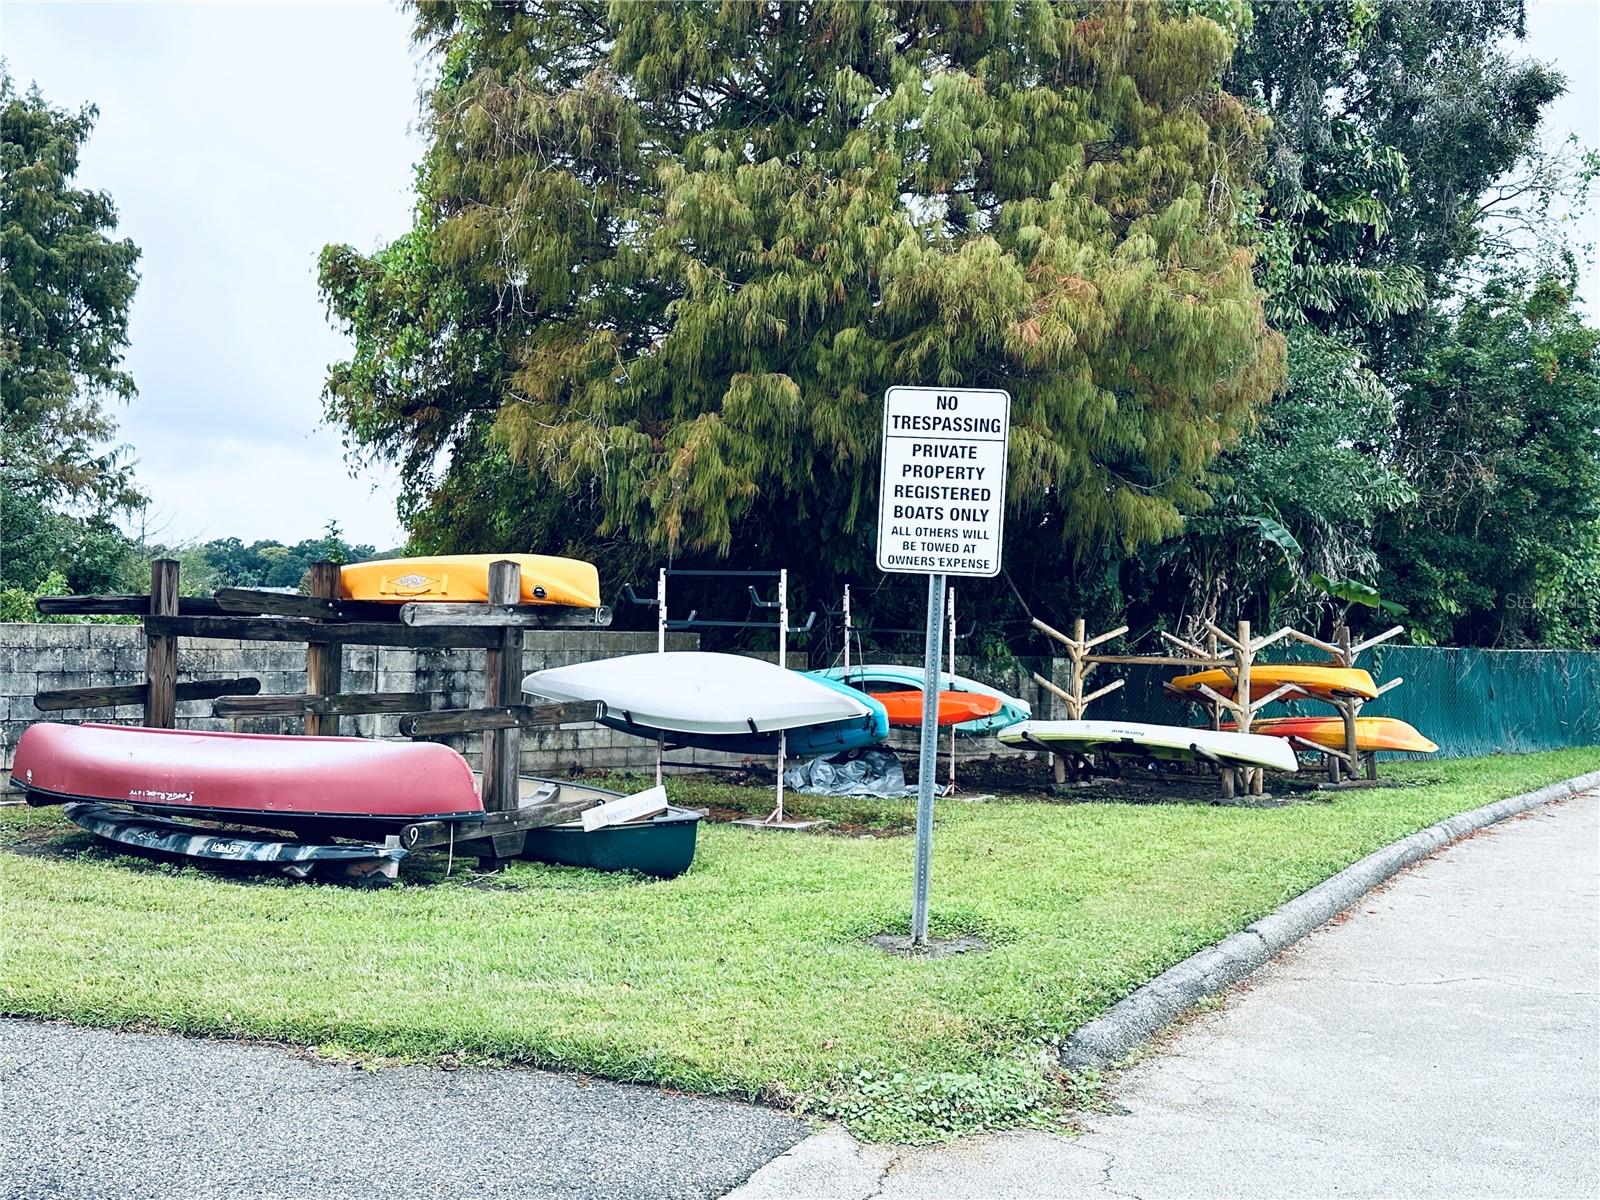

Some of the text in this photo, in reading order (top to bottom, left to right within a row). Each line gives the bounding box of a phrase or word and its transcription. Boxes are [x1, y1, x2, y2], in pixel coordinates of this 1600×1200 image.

[936, 395, 958, 411] NO
[892, 414, 1001, 433] TRESPASSING
[912, 443, 978, 460] PRIVATE
[902, 464, 986, 481] PROPERTY
[894, 484, 991, 502] REGISTERED
[893, 505, 990, 523] BOATS ONLY
[891, 525, 990, 540] ALL OTHERS WILL
[902, 540, 977, 554] BE TOWED AT
[939, 557, 990, 570] EXPENSE
[410, 716, 419, 734] 8
[410, 827, 419, 846] 9
